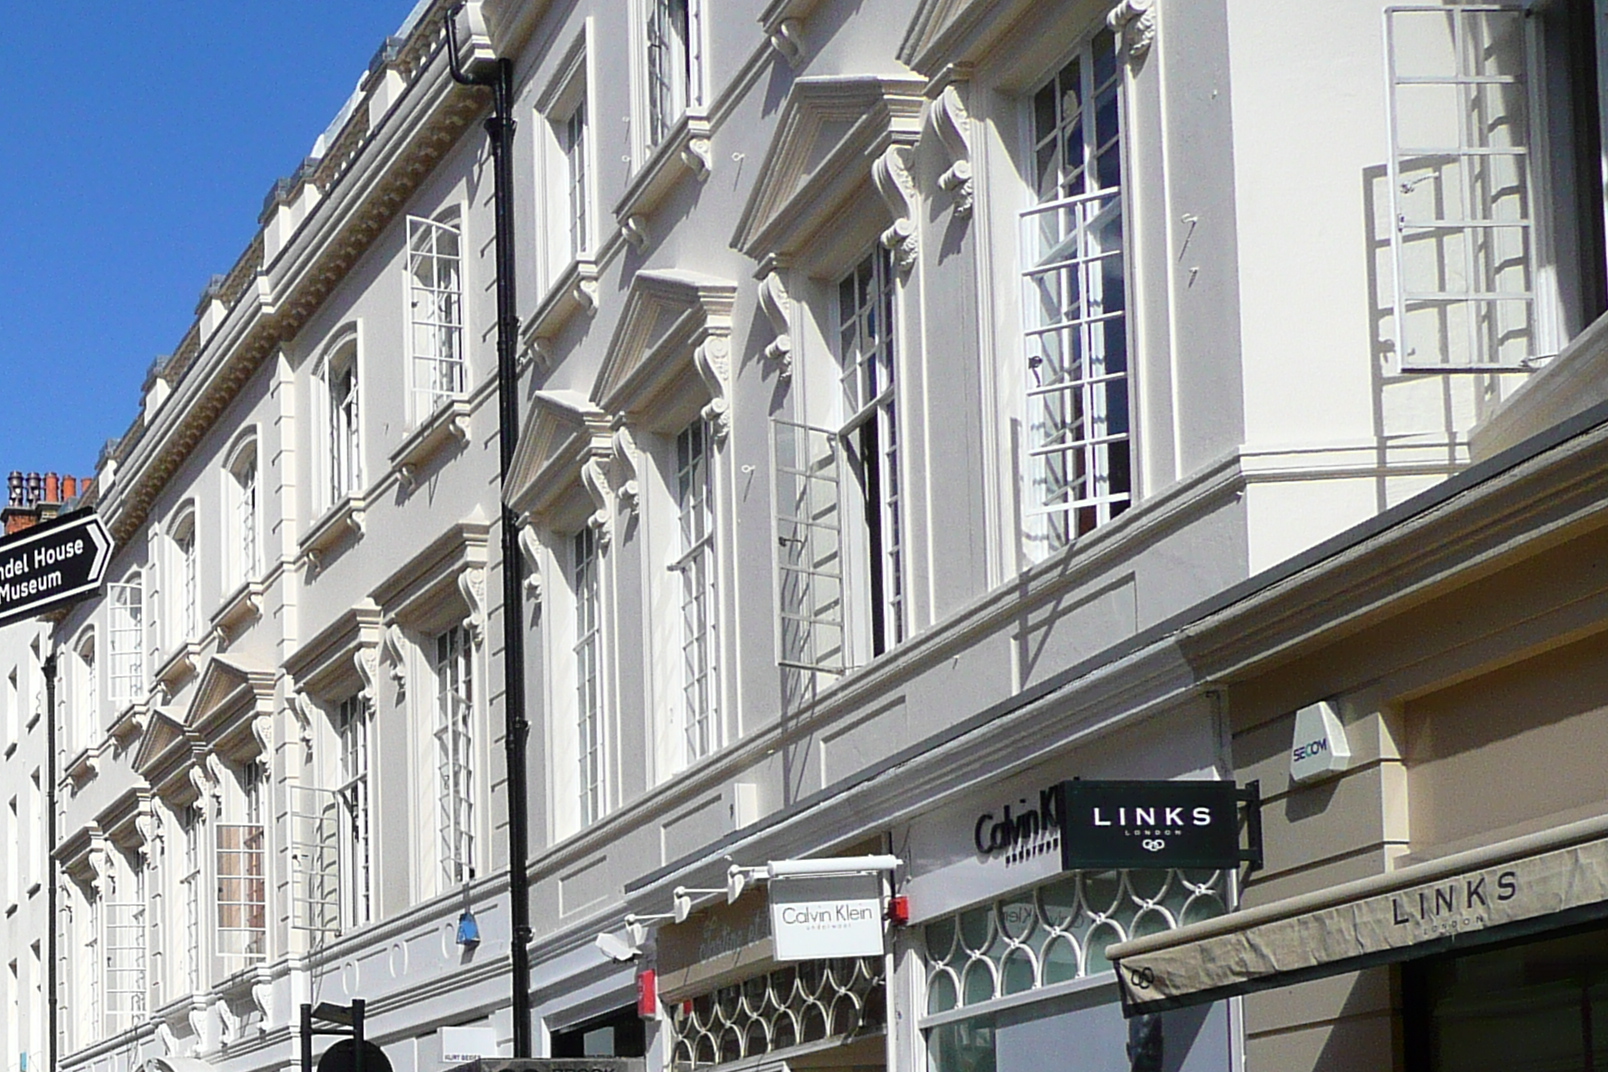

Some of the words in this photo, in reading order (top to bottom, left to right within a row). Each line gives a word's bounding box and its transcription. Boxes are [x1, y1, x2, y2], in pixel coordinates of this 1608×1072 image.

[34, 538, 84, 568] House
[1293, 738, 1327, 762] SECOM
[975, 798, 1039, 854] Calvin
[1093, 807, 1211, 826] LINKS
[1392, 871, 1516, 926] LINKS
[782, 906, 832, 925] Calvin
[835, 903, 873, 922] Klein
[1423, 914, 1485, 936] LONDON
